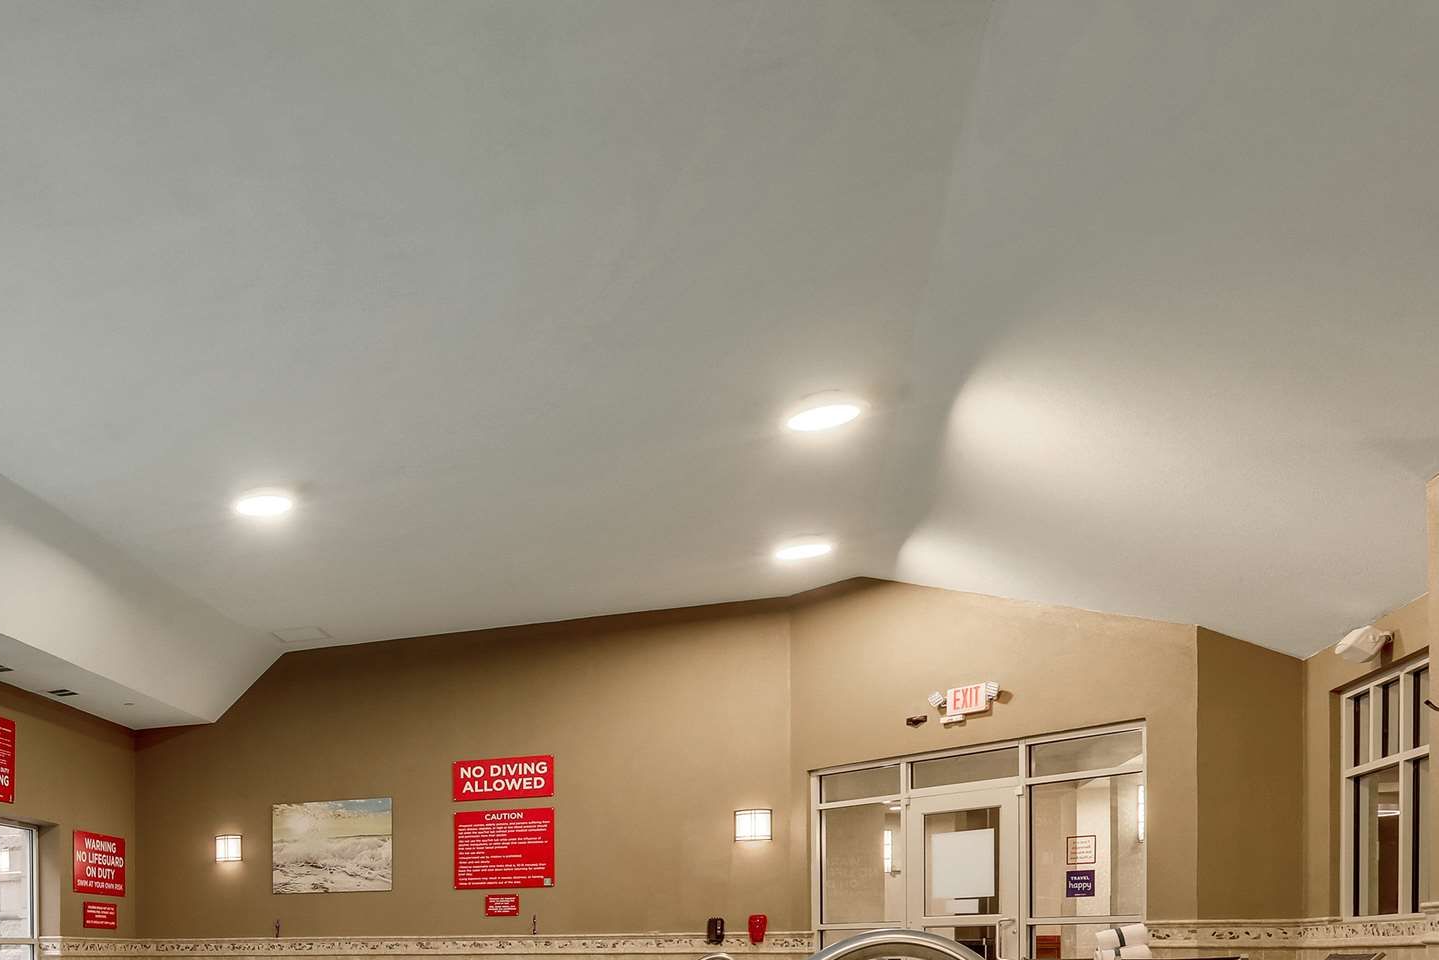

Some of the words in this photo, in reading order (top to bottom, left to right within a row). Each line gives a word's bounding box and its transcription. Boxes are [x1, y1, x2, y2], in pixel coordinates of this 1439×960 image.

[953, 686, 981, 711] EXIT
[460, 766, 485, 779] NO
[490, 761, 548, 777] DIVING
[462, 777, 545, 793] ALLOWED
[484, 812, 524, 821] CAUTION
[84, 837, 117, 853] WARNING
[76, 850, 87, 862] NO
[88, 852, 124, 868] LIFEGUARD
[86, 866, 97, 878] ON
[97, 867, 115, 880] DUTY
[1068, 881, 1092, 891] happy
